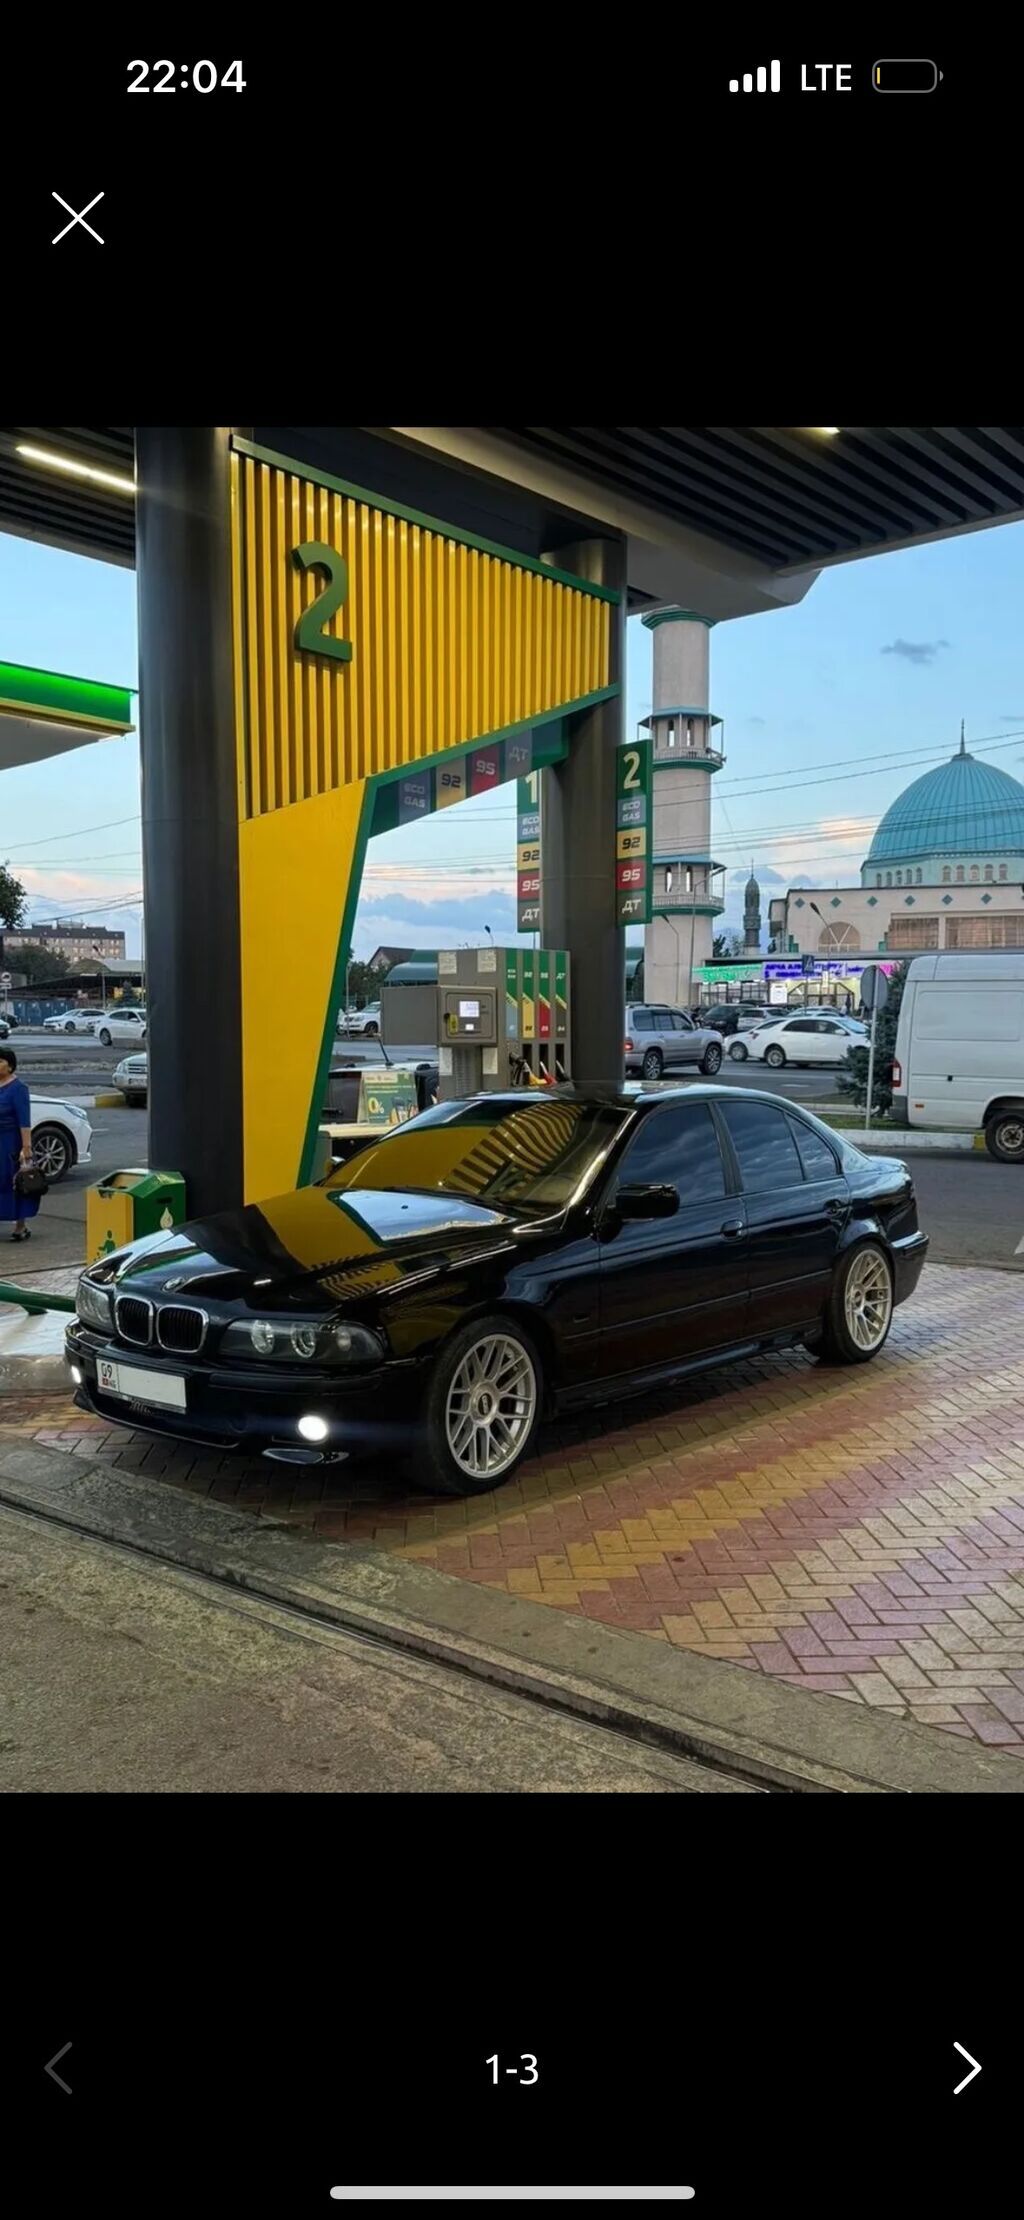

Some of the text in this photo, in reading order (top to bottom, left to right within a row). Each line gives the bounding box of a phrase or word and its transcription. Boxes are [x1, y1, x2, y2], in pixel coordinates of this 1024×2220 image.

[290, 540, 352, 662] 2
[509, 746, 528, 762] ДТ
[476, 760, 495, 776] 95
[623, 751, 640, 789] 2
[441, 773, 461, 788] 92
[525, 769, 537, 803] 1
[404, 783, 425, 795] ECO
[404, 796, 426, 808] GAS
[622, 836, 640, 850] 92
[522, 849, 540, 862] 92
[622, 868, 641, 882] 95
[522, 880, 540, 892] 95
[621, 899, 642, 914] ДТ
[521, 908, 540, 922] ДТ
[101, 1362, 112, 1378] 09
